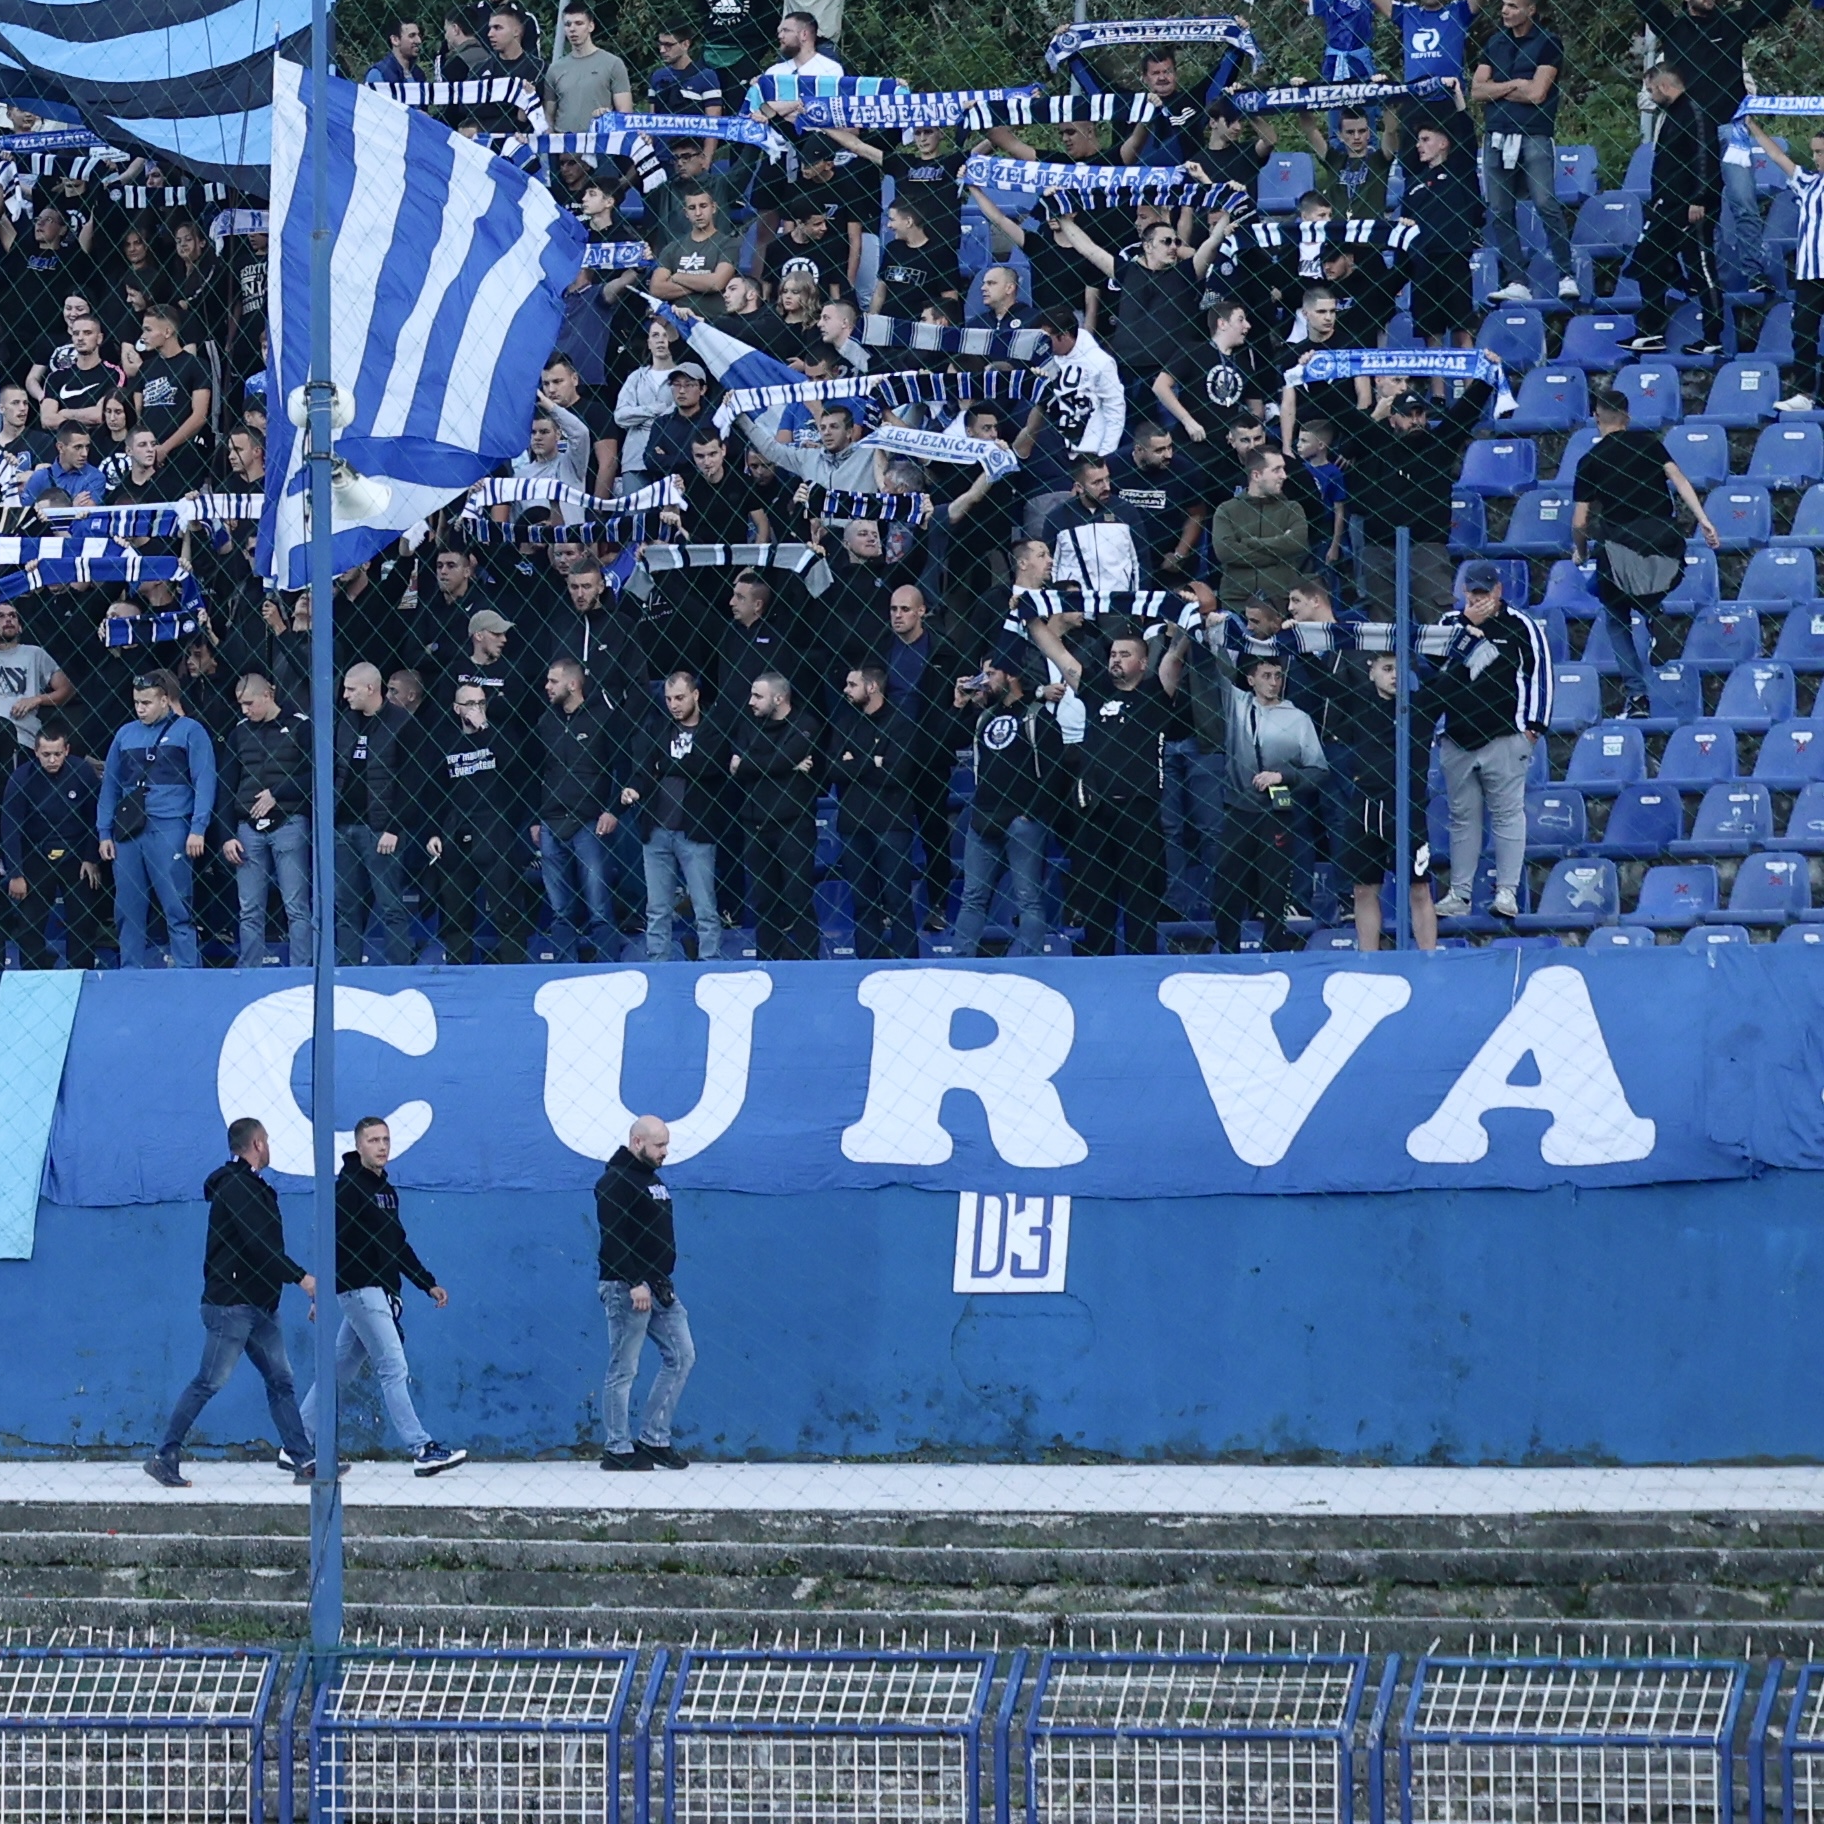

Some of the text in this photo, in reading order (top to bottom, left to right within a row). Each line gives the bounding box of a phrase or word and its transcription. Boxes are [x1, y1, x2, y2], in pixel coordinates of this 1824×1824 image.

[712, 5, 742, 15] adidas
[217, 965, 1659, 1177] CURVA
[970, 1194, 1053, 1279] D3
